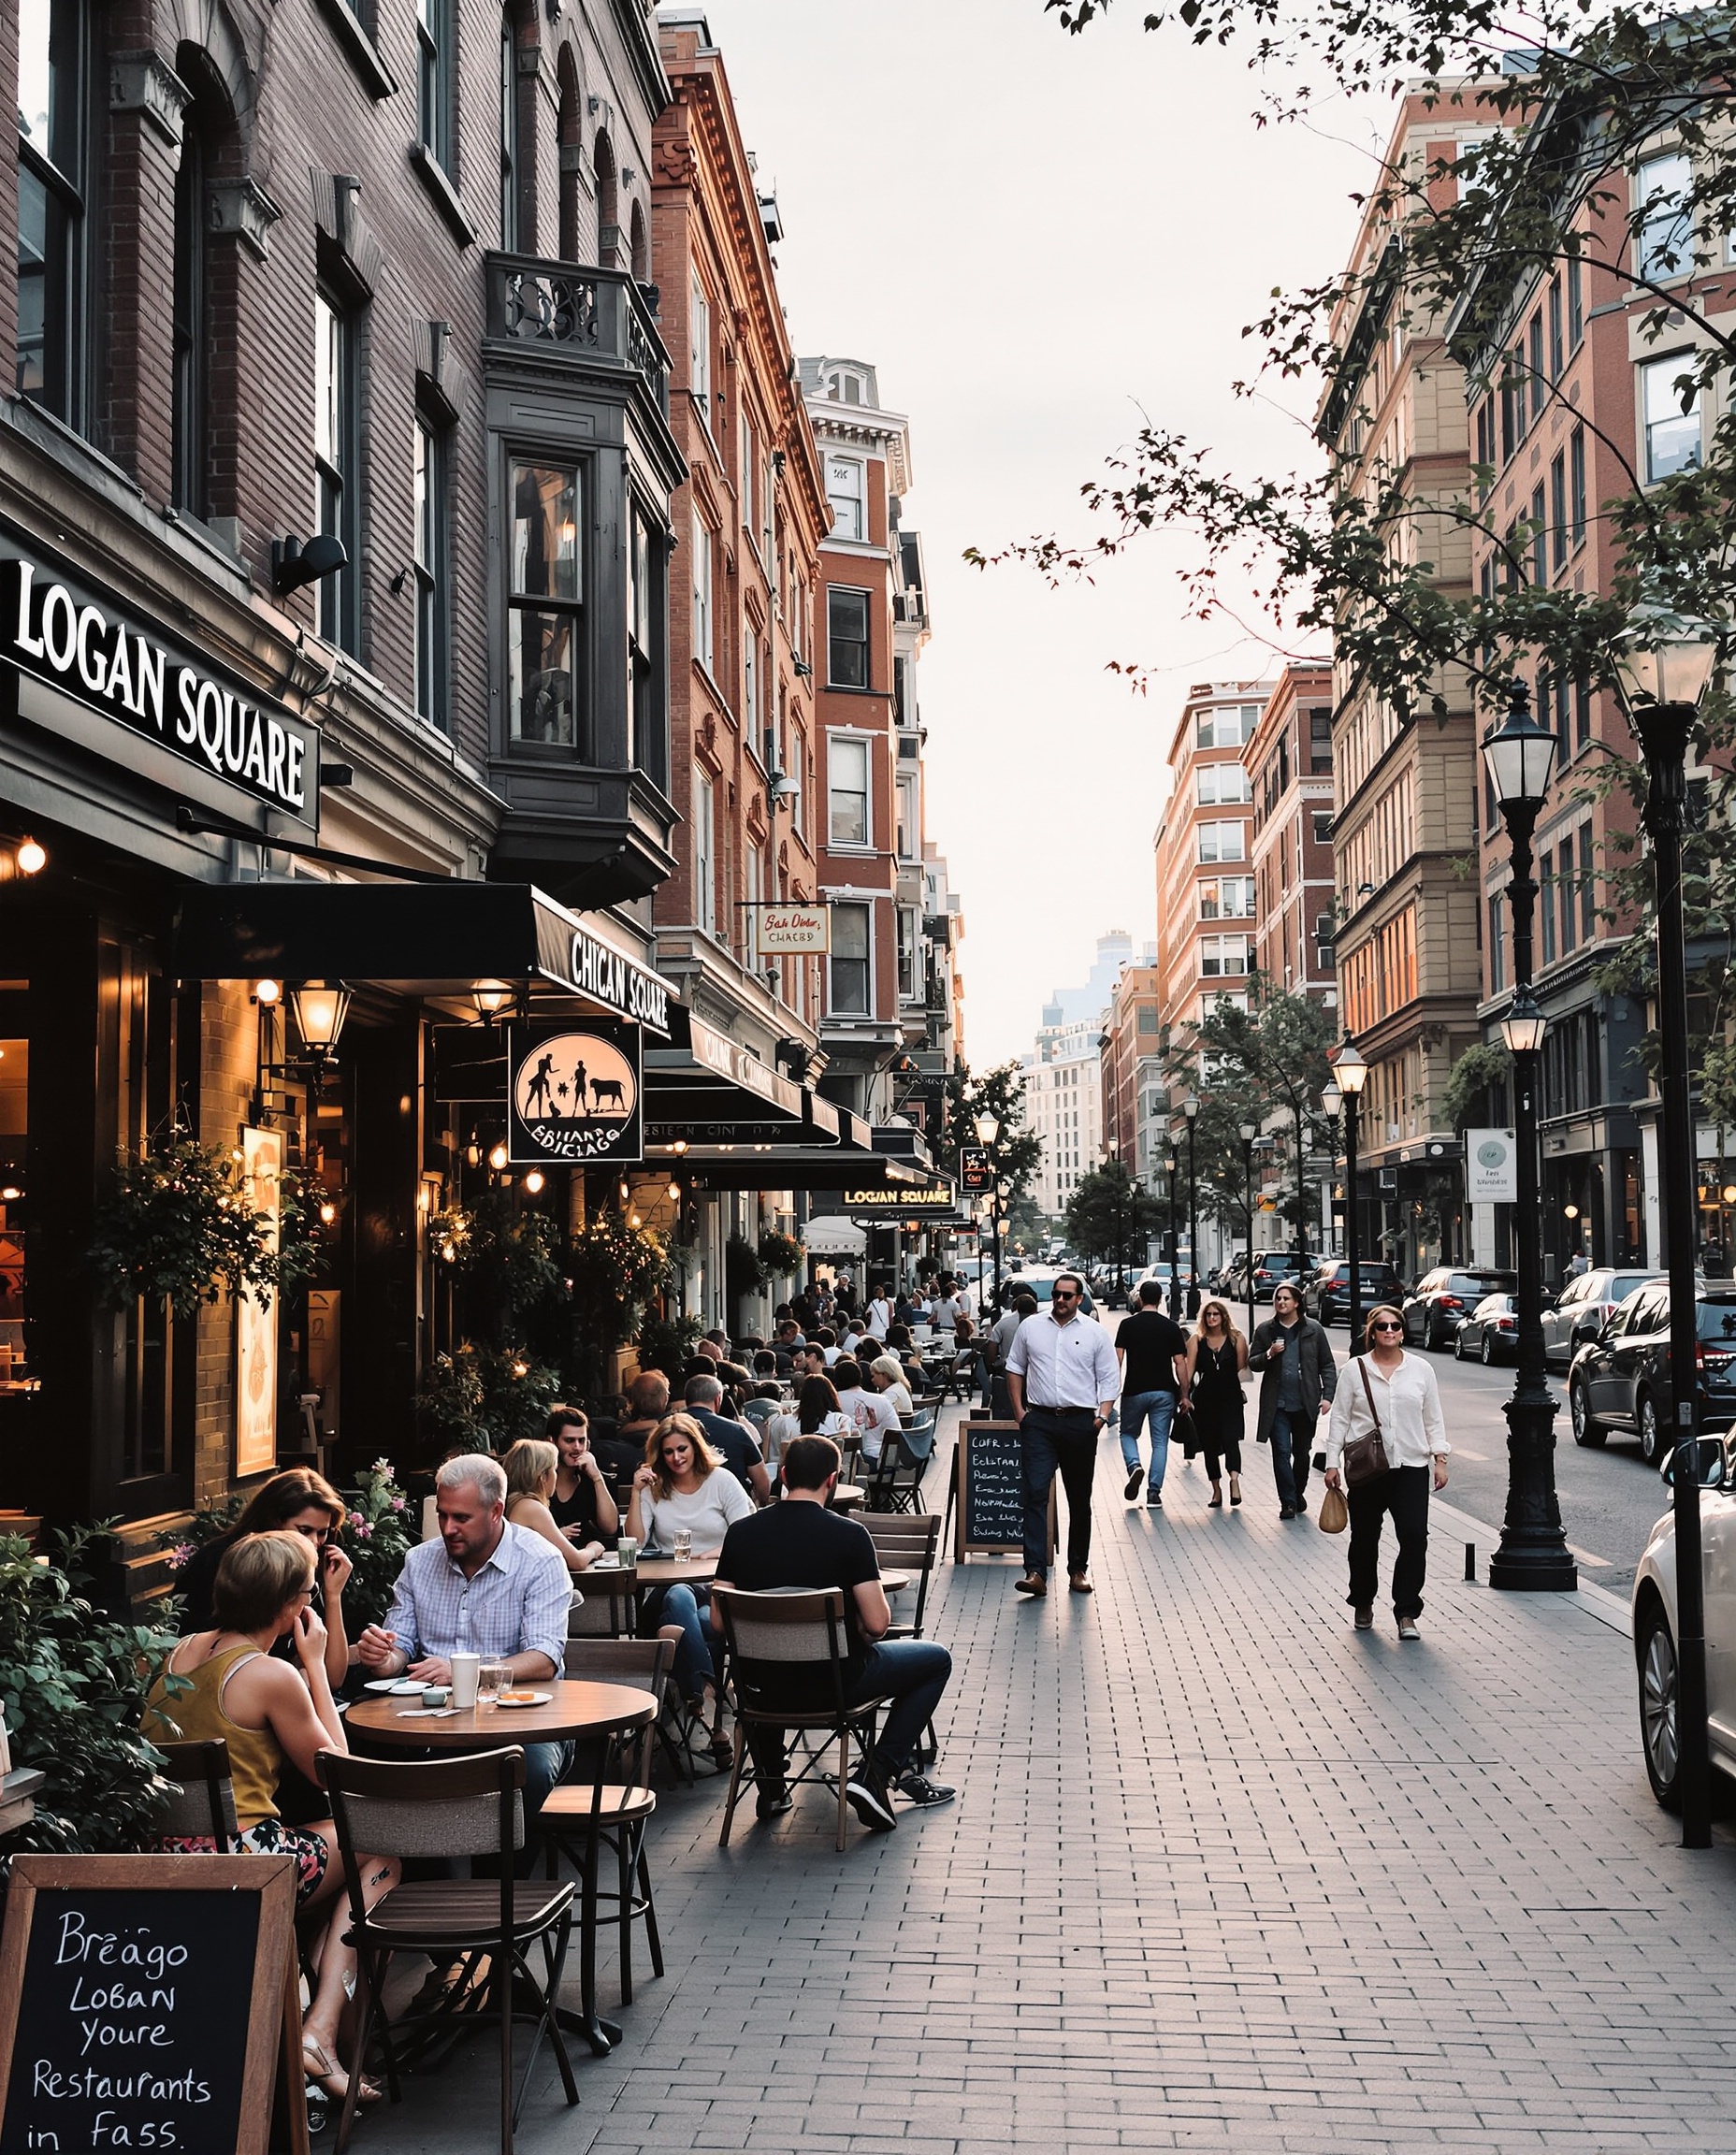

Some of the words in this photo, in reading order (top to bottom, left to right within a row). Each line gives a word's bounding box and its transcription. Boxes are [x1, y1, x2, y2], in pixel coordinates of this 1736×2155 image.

[14, 559, 168, 731] LOGAN
[176, 665, 306, 809] SQUARE
[33, 2059, 212, 2104] Restaurants
[27, 2124, 60, 2151] in
